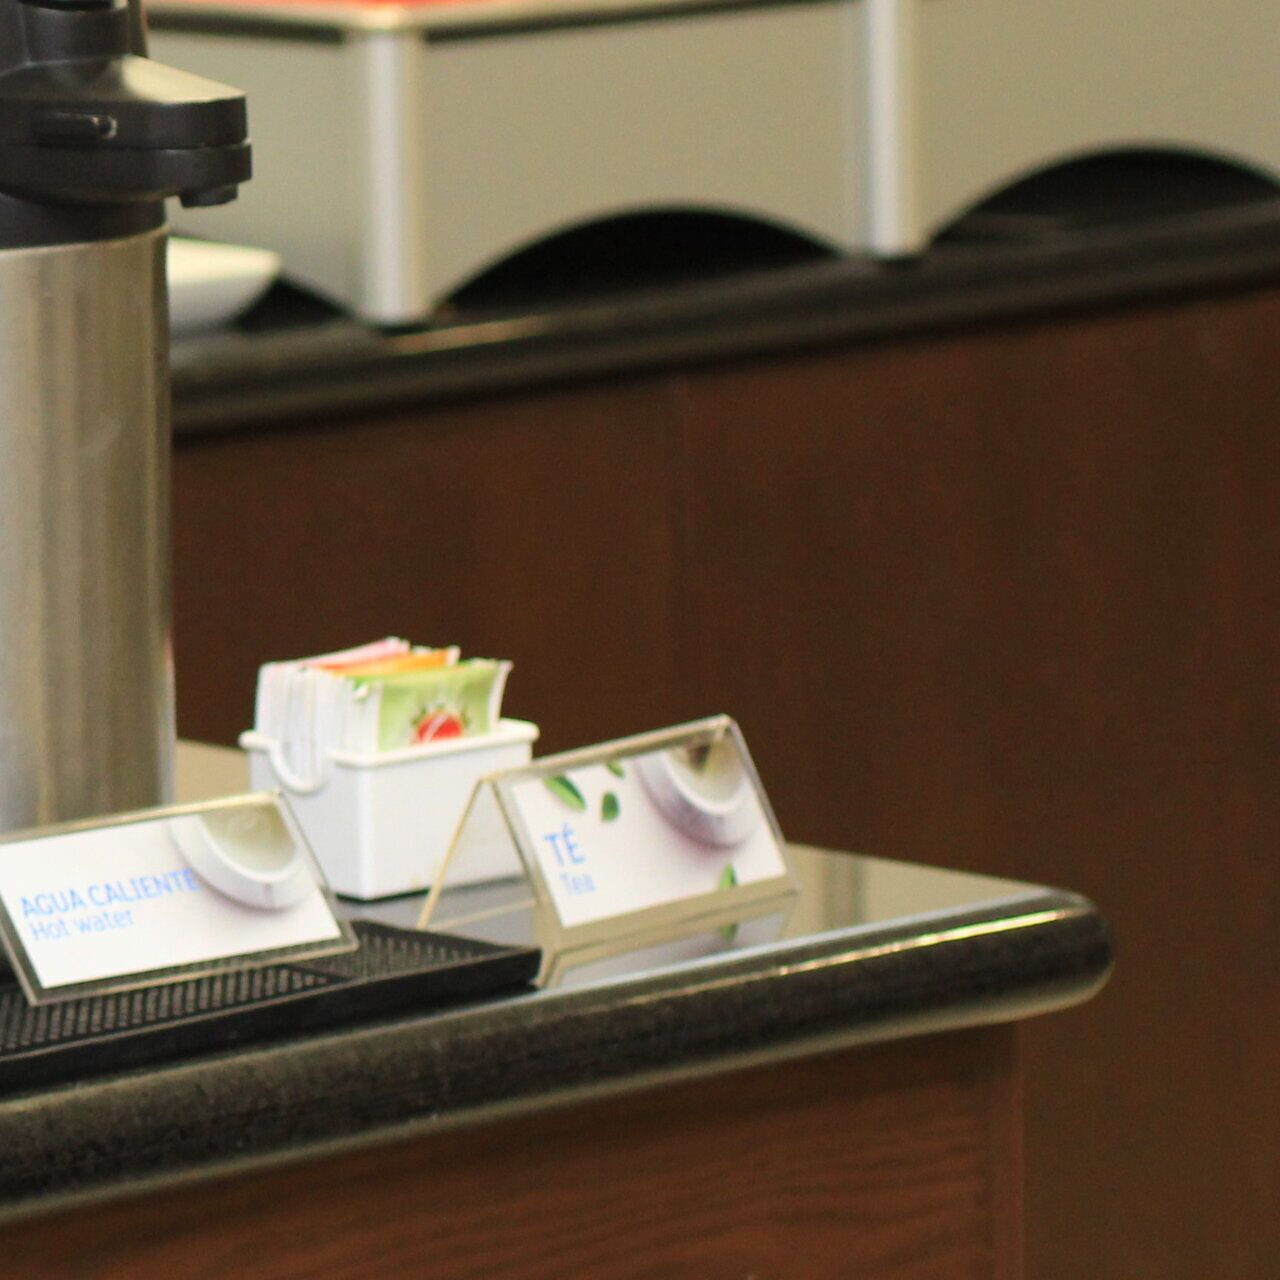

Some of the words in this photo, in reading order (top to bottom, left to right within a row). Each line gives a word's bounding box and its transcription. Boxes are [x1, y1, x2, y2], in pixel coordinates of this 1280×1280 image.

[543, 821, 587, 867] TÉ
[20, 889, 85, 918] AGUA
[87, 868, 201, 905] CALIENTE
[28, 919, 70, 942] Hot
[77, 910, 135, 936] water
